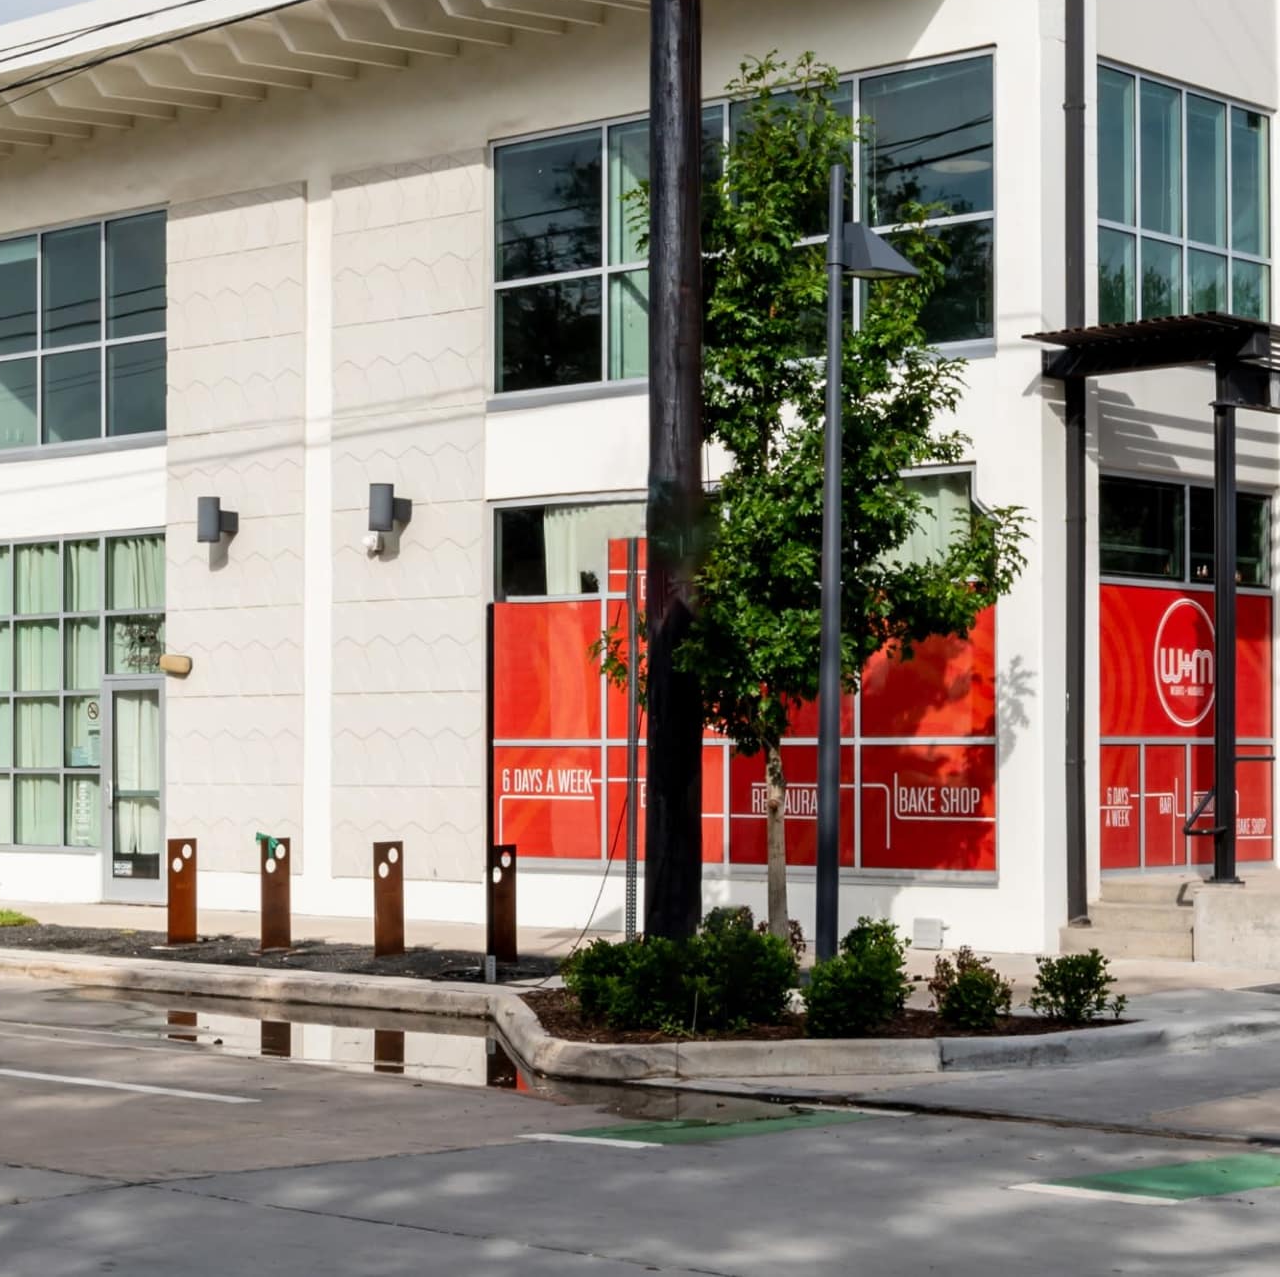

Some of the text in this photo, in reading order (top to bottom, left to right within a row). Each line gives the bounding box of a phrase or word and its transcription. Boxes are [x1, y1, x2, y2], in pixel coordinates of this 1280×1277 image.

[502, 768, 593, 794] 6 DAYS A WEEK
[899, 786, 980, 814] BAKE SHOP
[1113, 786, 1129, 805] DAYS
[1105, 809, 1130, 827] A WEEK
